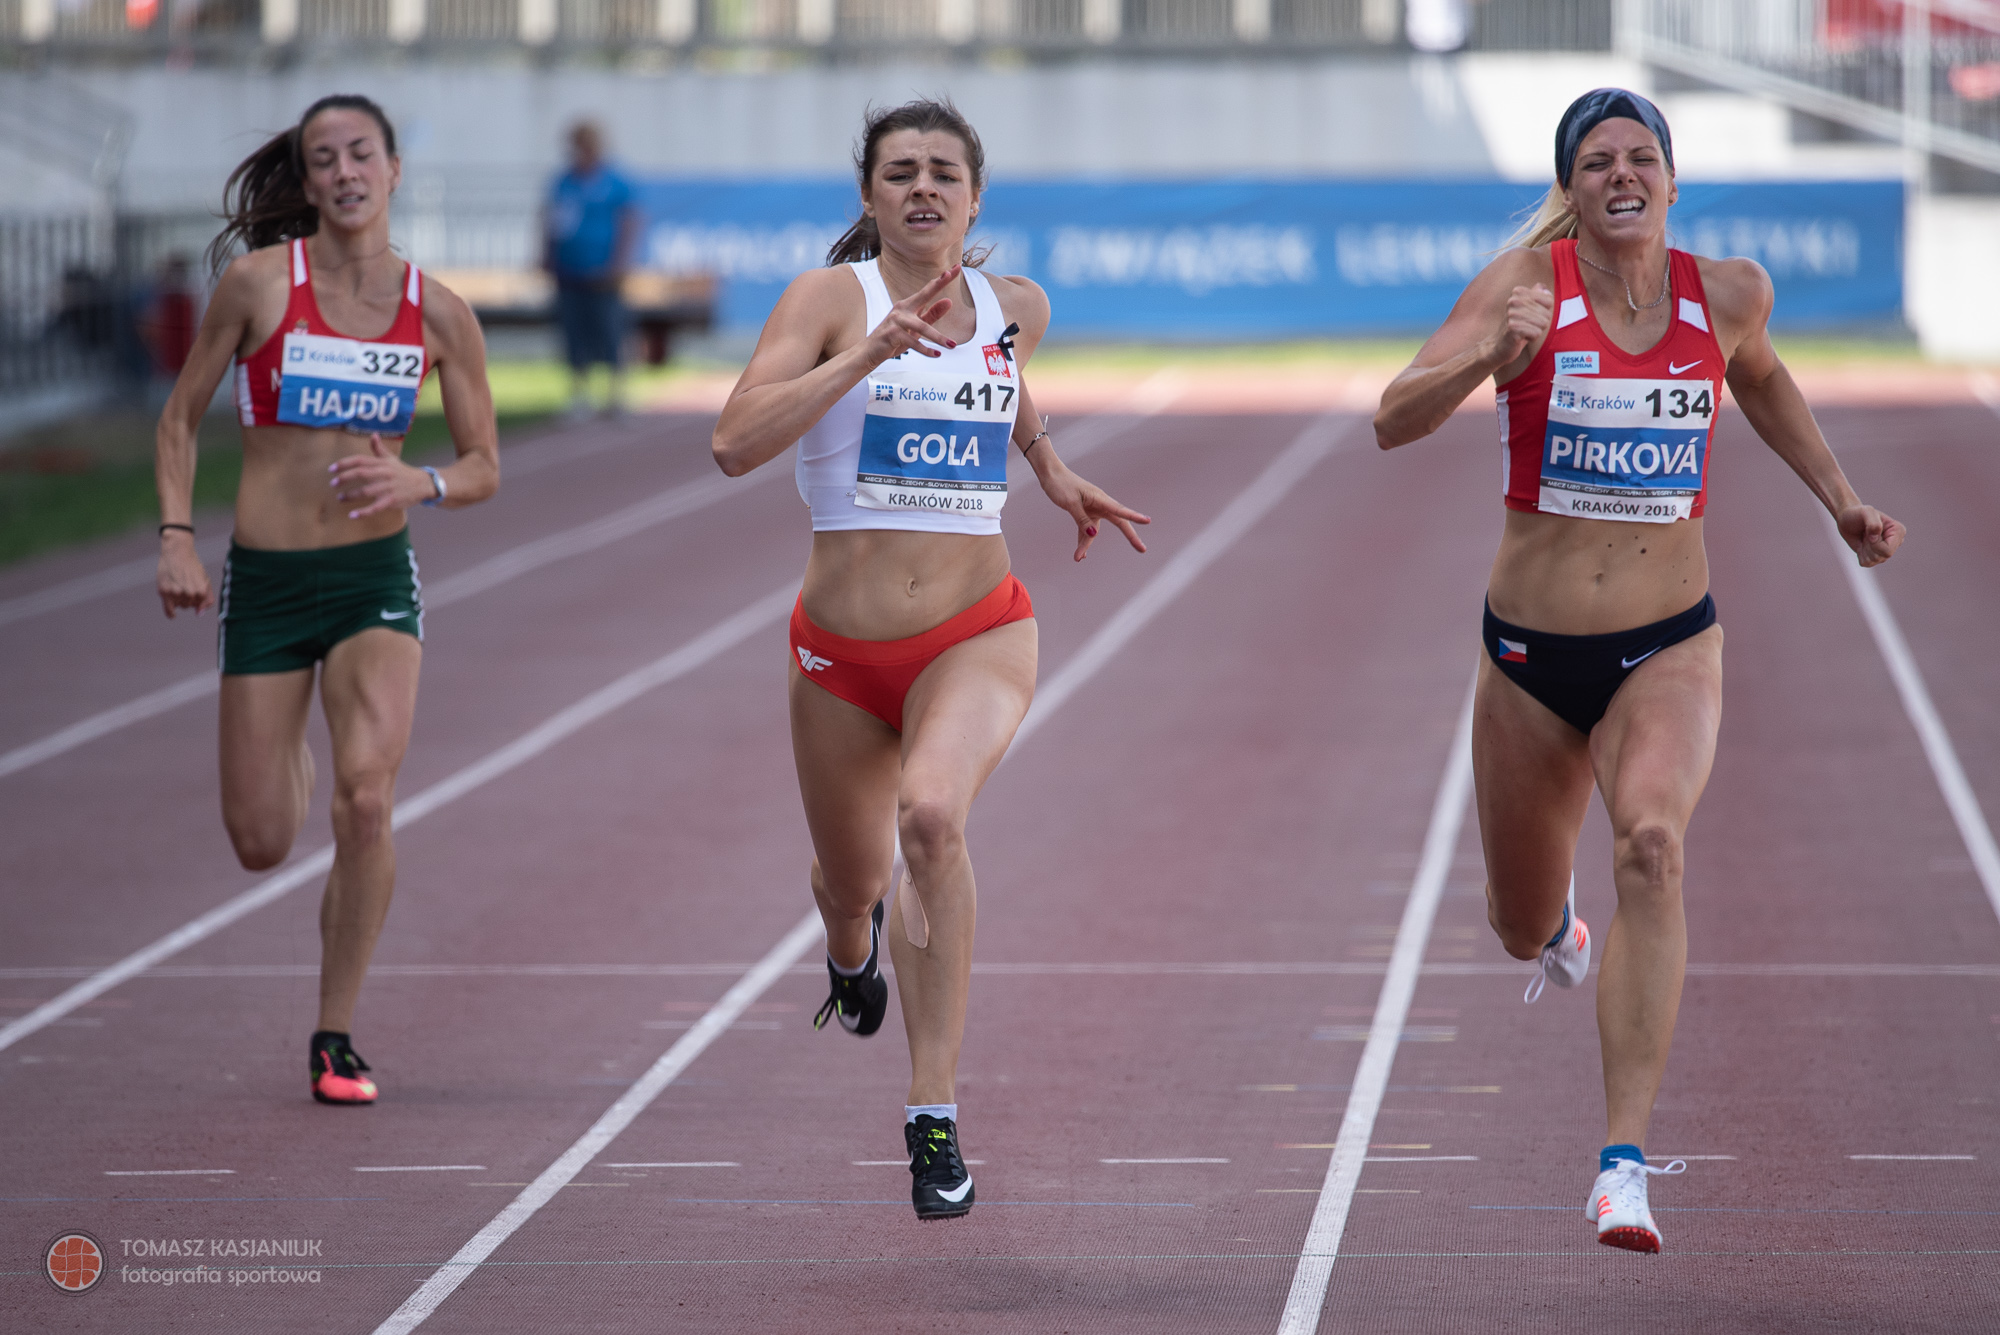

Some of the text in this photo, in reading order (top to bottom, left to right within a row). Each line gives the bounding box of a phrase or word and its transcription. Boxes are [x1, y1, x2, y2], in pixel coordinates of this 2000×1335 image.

[309, 350, 420, 378] Kraków 322
[299, 386, 401, 423] HAJDÚ
[899, 382, 1015, 412] Kraków 417
[1581, 388, 1713, 419] Kraków 134
[897, 432, 980, 467] GOLA
[1550, 433, 1699, 475] PÍRKOVÁ
[888, 493, 983, 510] KRAKÓW 2018
[1572, 499, 1677, 516] KRAKÓW 2018
